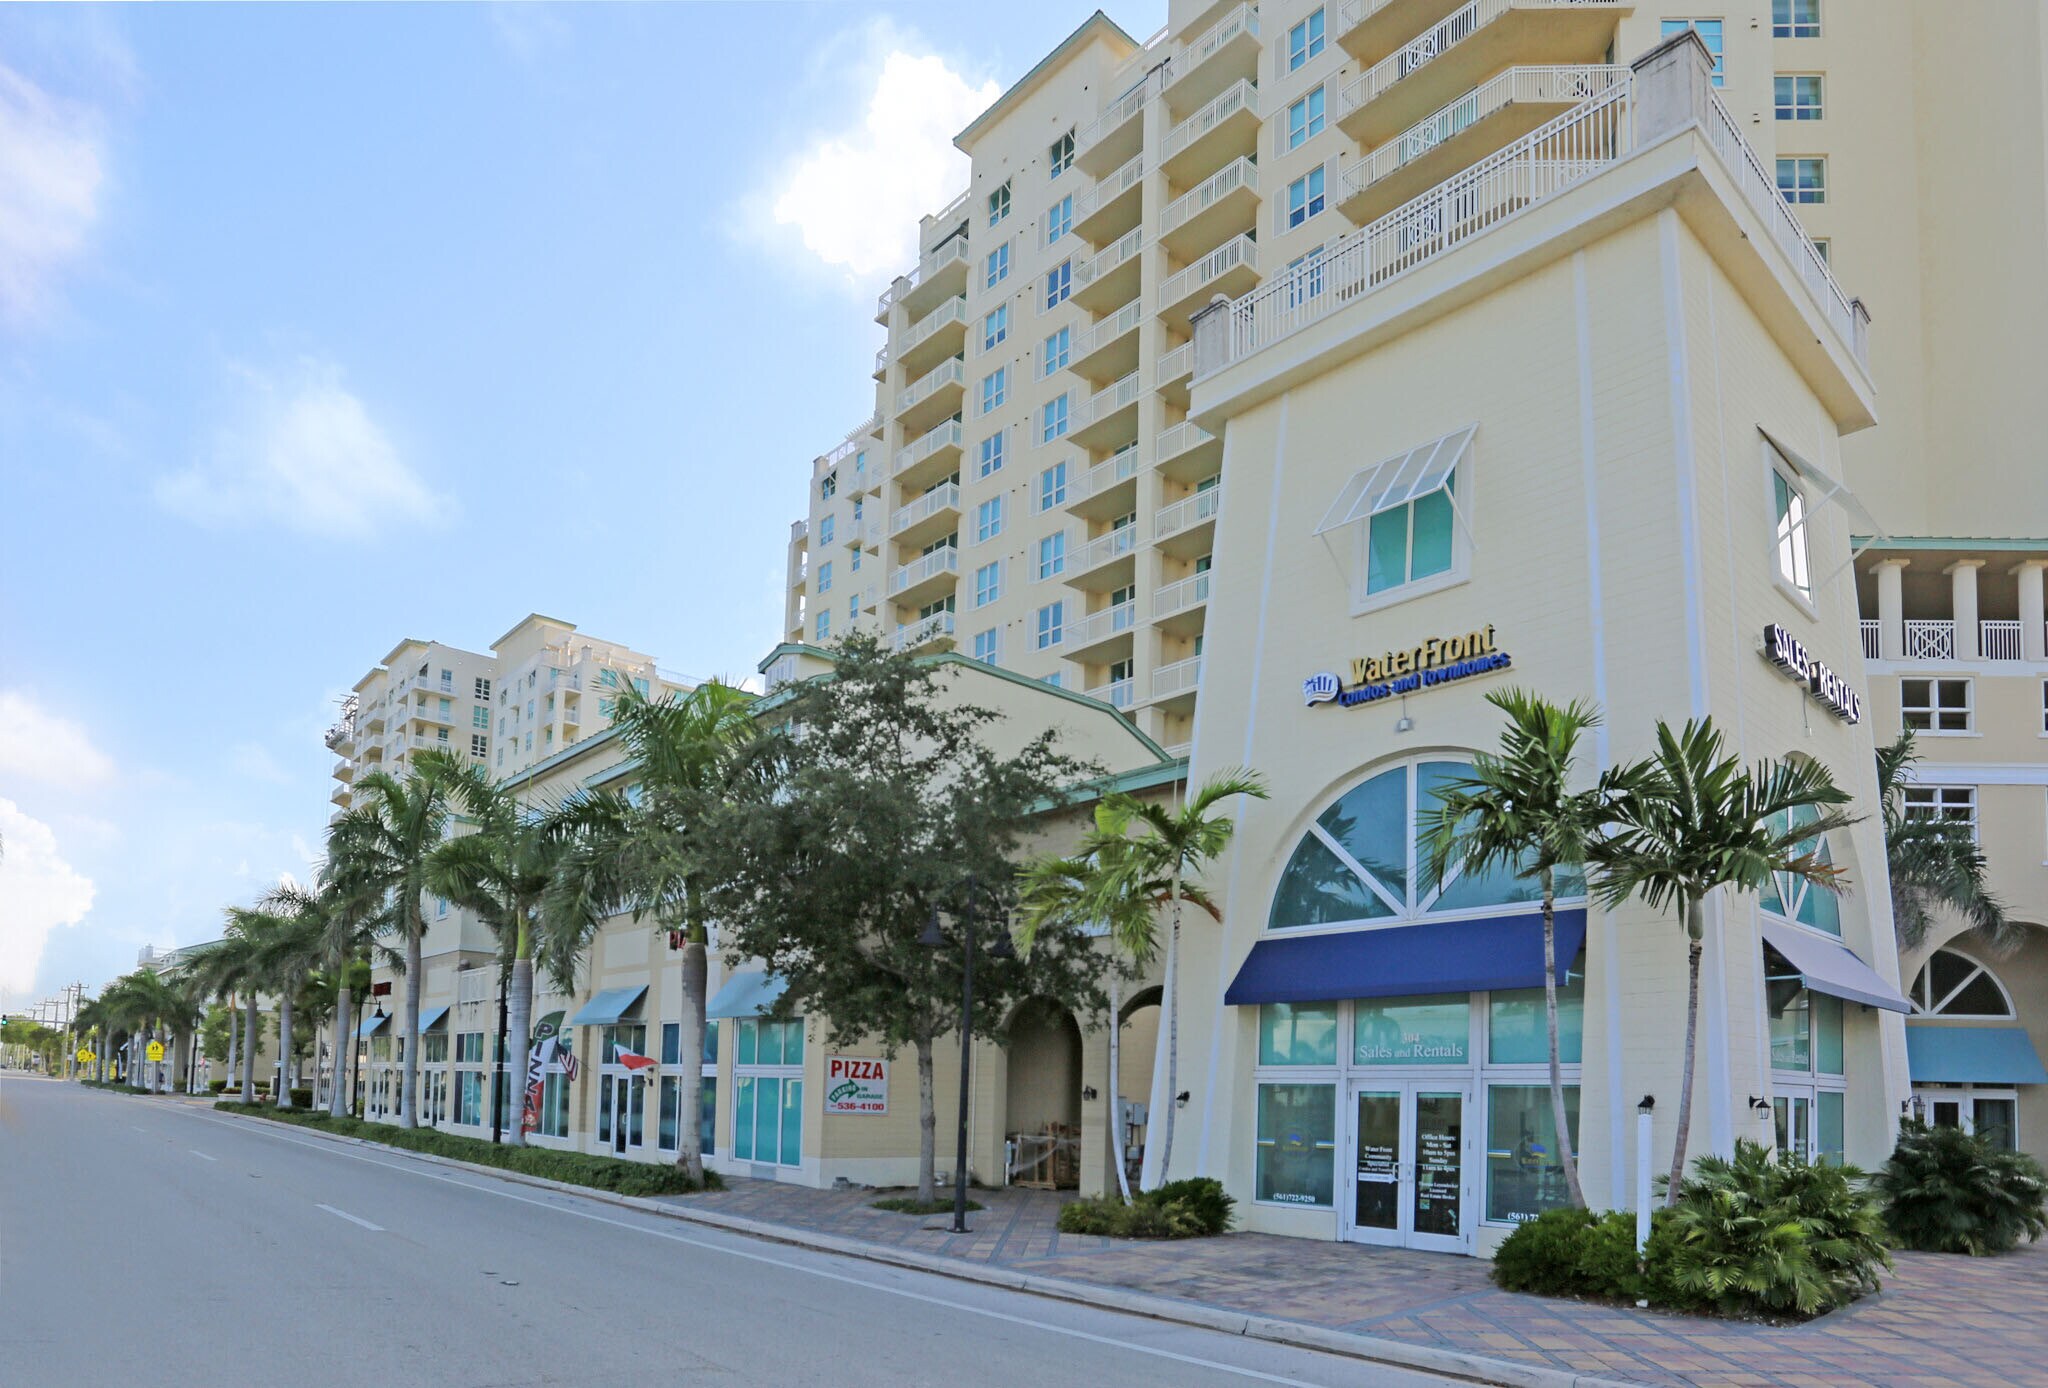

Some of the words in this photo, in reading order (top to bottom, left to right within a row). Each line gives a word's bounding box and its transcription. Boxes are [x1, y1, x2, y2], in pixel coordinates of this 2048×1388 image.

[1338, 680, 1391, 707] Condos
[1390, 671, 1419, 695] and
[1420, 652, 1511, 686] Townhomes
[1351, 624, 1497, 685] WaterFront
[1768, 623, 1810, 682] SALES
[1813, 660, 1861, 724] RENTALS
[831, 1060, 884, 1080] PIZZA
[1360, 1044, 1393, 1058] Sales
[1395, 1048, 1410, 1058] and
[1413, 1043, 1464, 1058] Rentals
[838, 1102, 884, 1110] 536-4100
